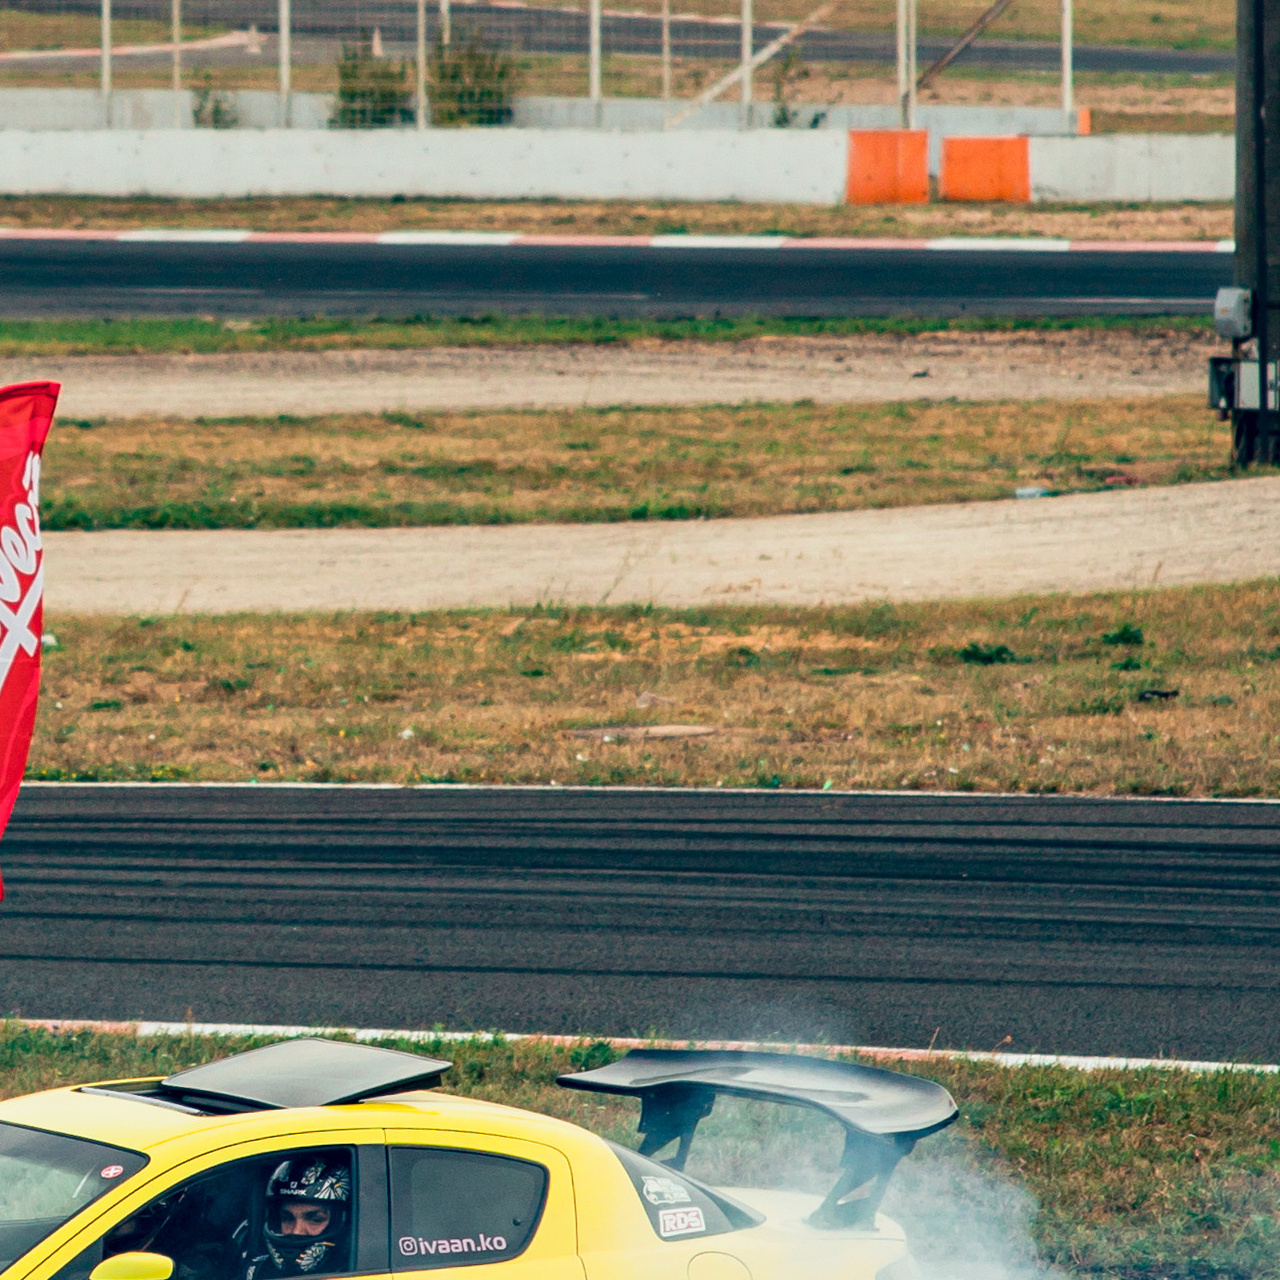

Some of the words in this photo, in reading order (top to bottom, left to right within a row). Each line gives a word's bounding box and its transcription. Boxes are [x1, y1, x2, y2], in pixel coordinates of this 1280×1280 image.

[279, 1188, 307, 1196] SHARK
[663, 1212, 702, 1232] RDS
[419, 1233, 507, 1256] ivaan.ko
